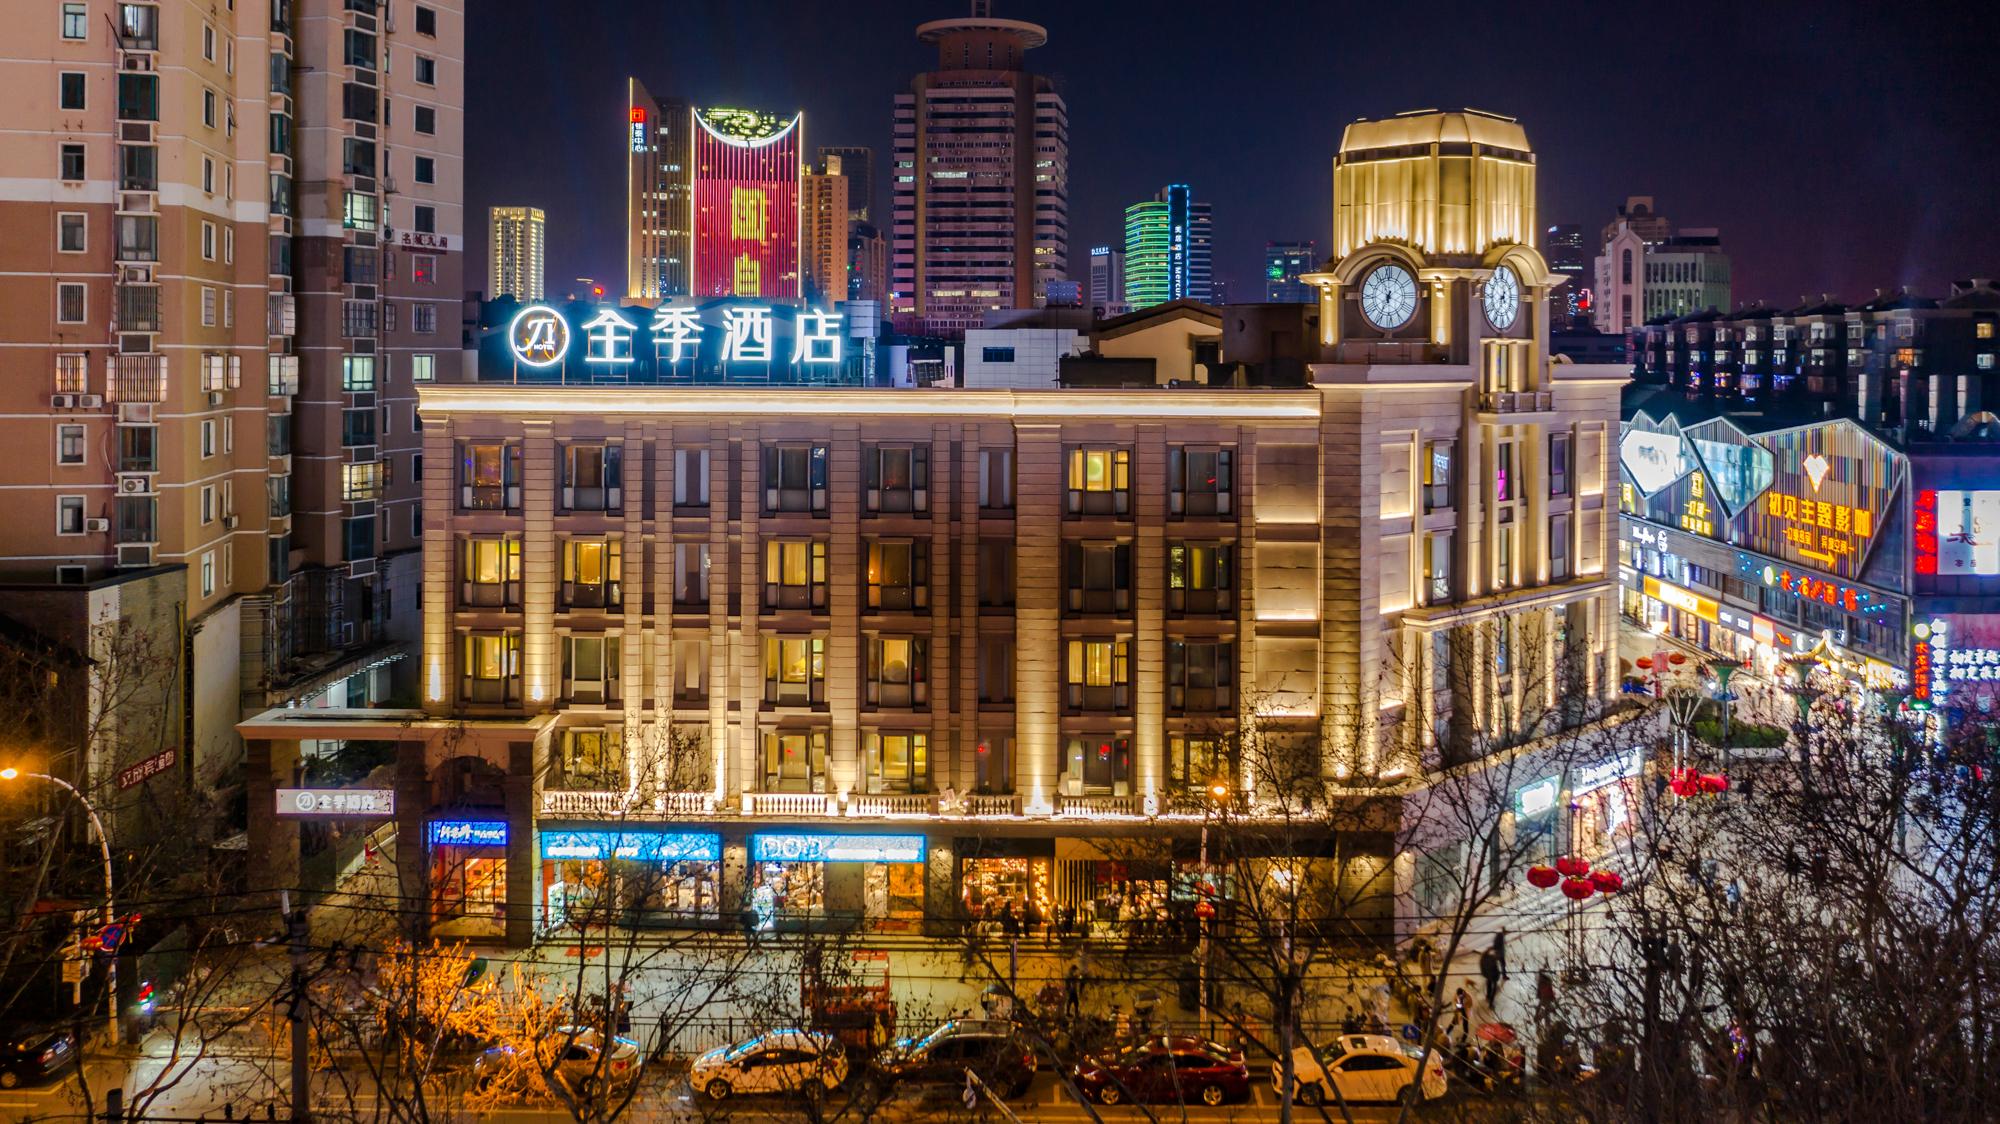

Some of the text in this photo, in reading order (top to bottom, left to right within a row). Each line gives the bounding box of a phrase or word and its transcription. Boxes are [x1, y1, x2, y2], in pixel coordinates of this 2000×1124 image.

[582, 307, 843, 364] 全季酒店
[318, 795, 375, 809] 全季酒店
